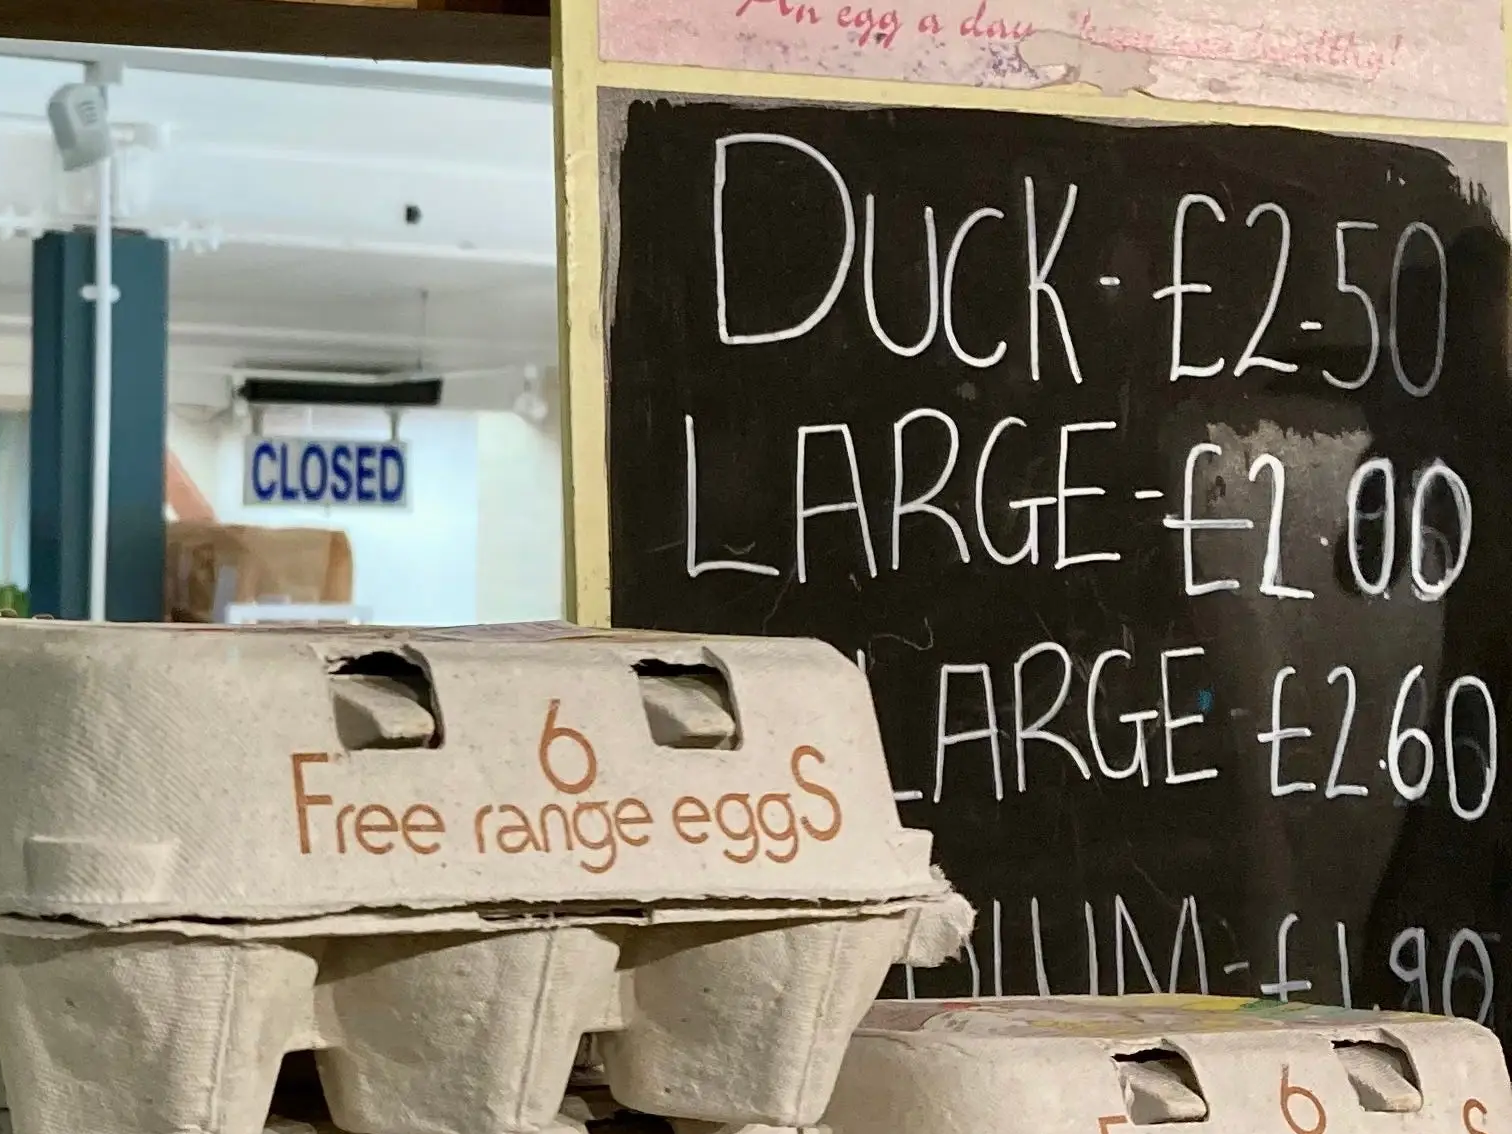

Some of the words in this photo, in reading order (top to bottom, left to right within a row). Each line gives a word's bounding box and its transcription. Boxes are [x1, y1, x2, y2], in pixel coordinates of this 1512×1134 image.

[838, 5, 902, 48] egg
[918, 13, 945, 34] a
[251, 442, 406, 502] CLOSED
[538, 699, 597, 794] 6
[857, 642, 1218, 803] ARGE
[1258, 664, 1497, 821] £2.60
[292, 752, 445, 855] Free
[475, 796, 653, 874] range
[672, 744, 843, 866] eggS
